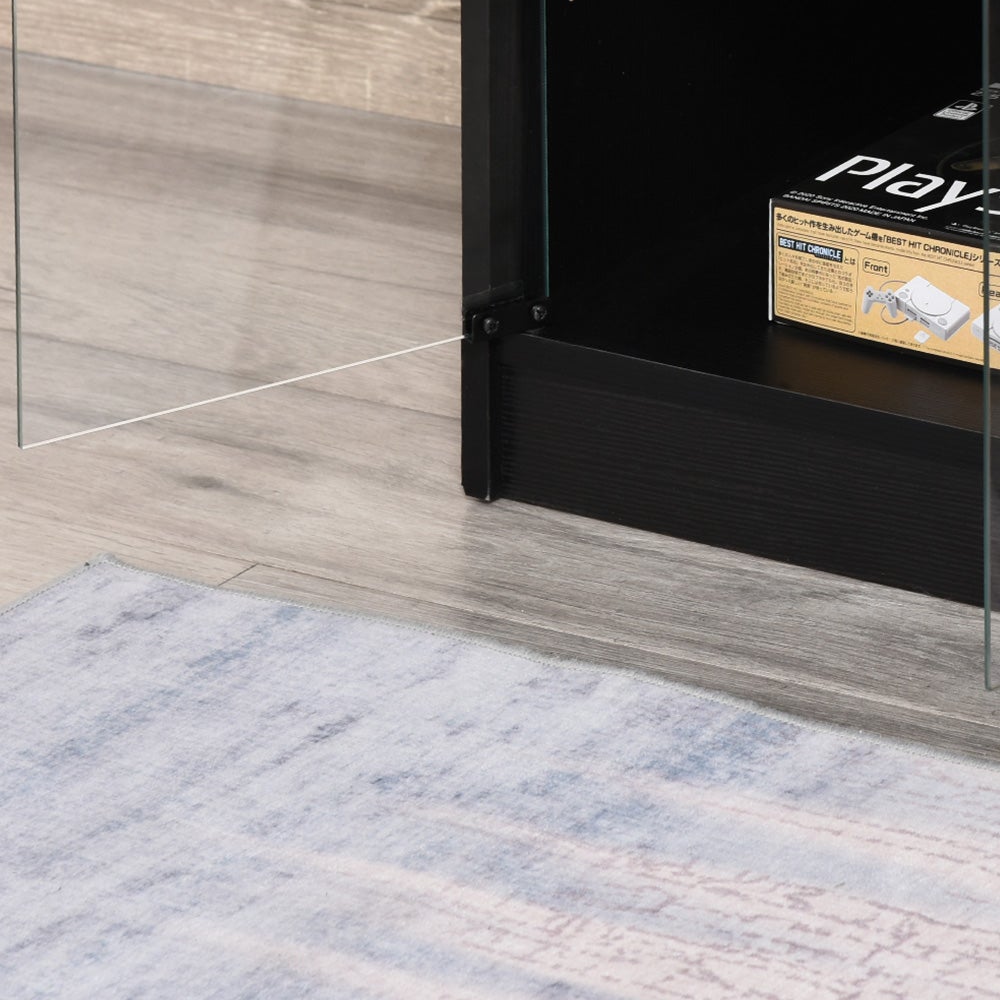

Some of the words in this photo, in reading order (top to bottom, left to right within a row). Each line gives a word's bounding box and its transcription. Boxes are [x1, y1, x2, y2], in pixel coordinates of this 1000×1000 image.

[780, 237, 795, 247] BEST
[795, 241, 806, 251] HIT
[807, 244, 842, 259] CHRONICLE
[908, 239, 922, 249] HIT
[864, 261, 888, 274] Front
